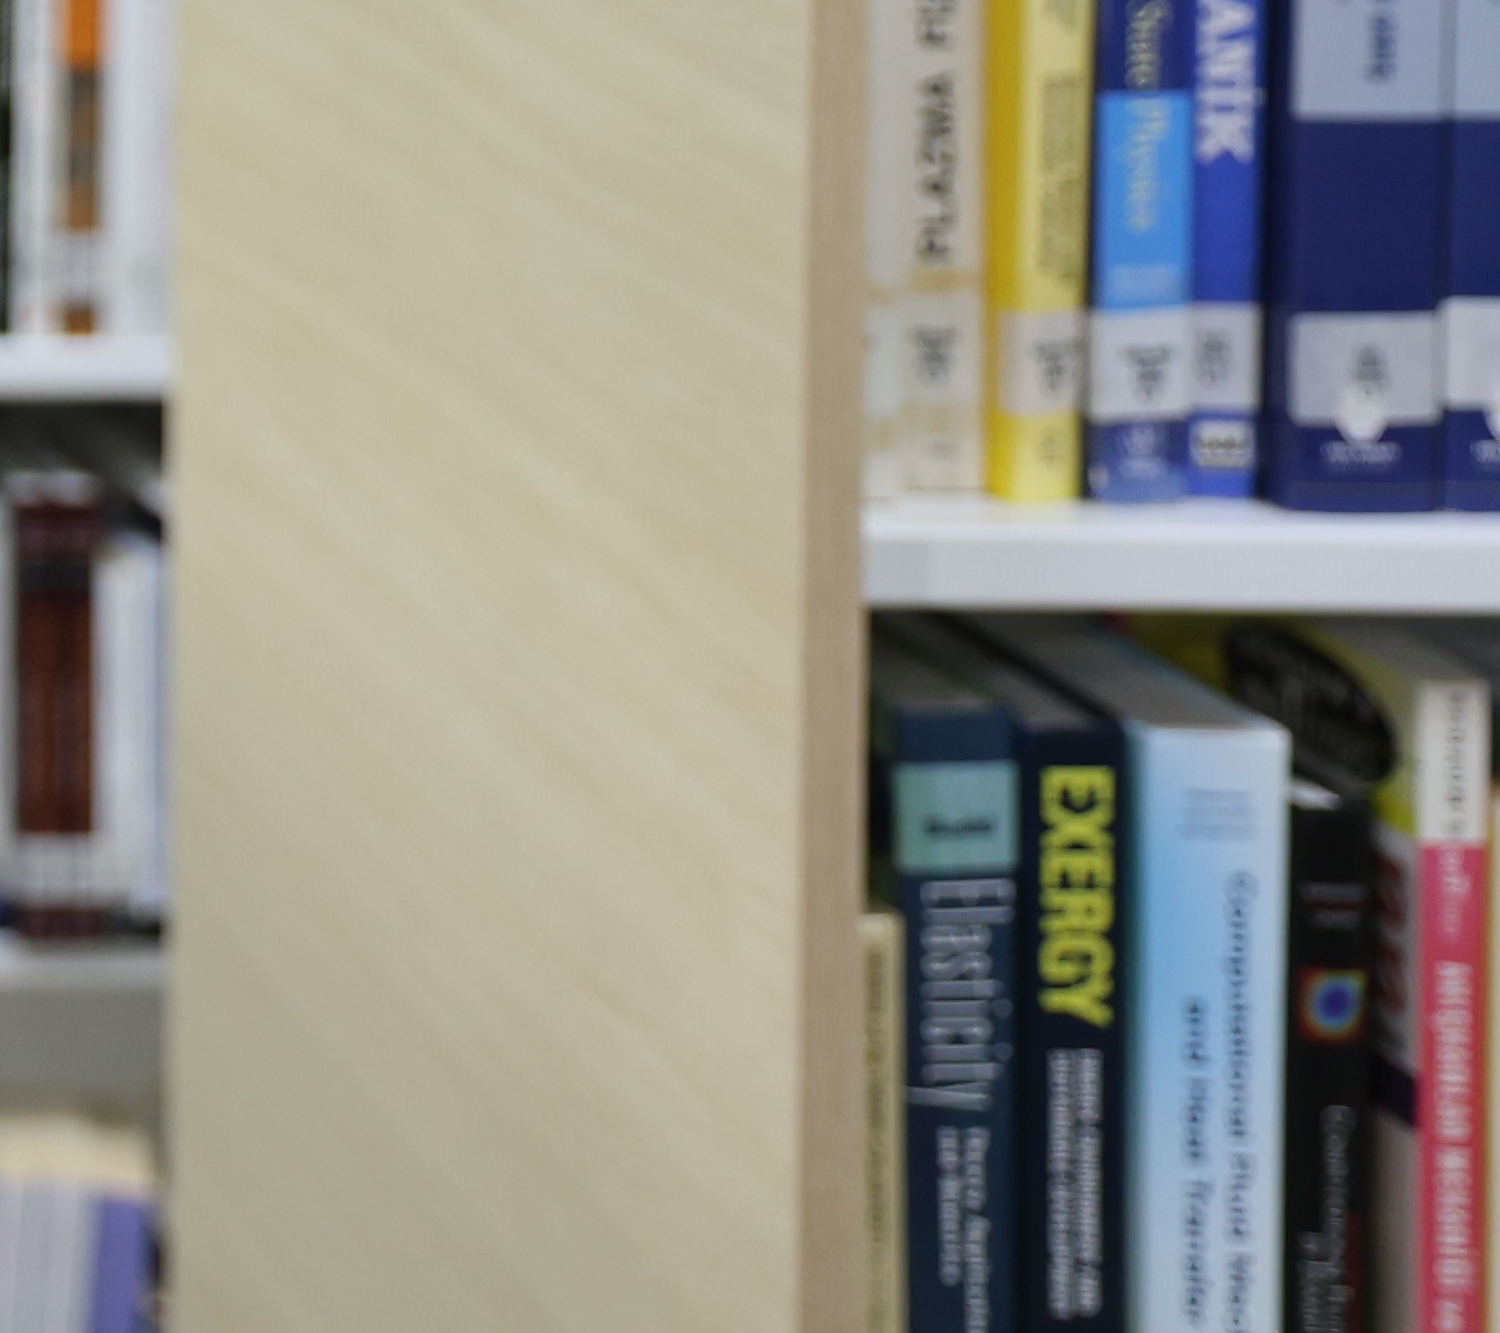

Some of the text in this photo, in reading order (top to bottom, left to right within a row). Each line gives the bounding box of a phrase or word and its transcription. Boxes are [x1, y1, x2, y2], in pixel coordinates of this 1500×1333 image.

[1125, 1, 1167, 94] State
[913, 72, 954, 264] PLAZMA
[1117, 98, 1173, 235] Physics
[1040, 766, 1111, 1025] EXERGY
[903, 879, 1015, 1108] Elasticity
[1178, 1174, 1212, 1328] Transfer
